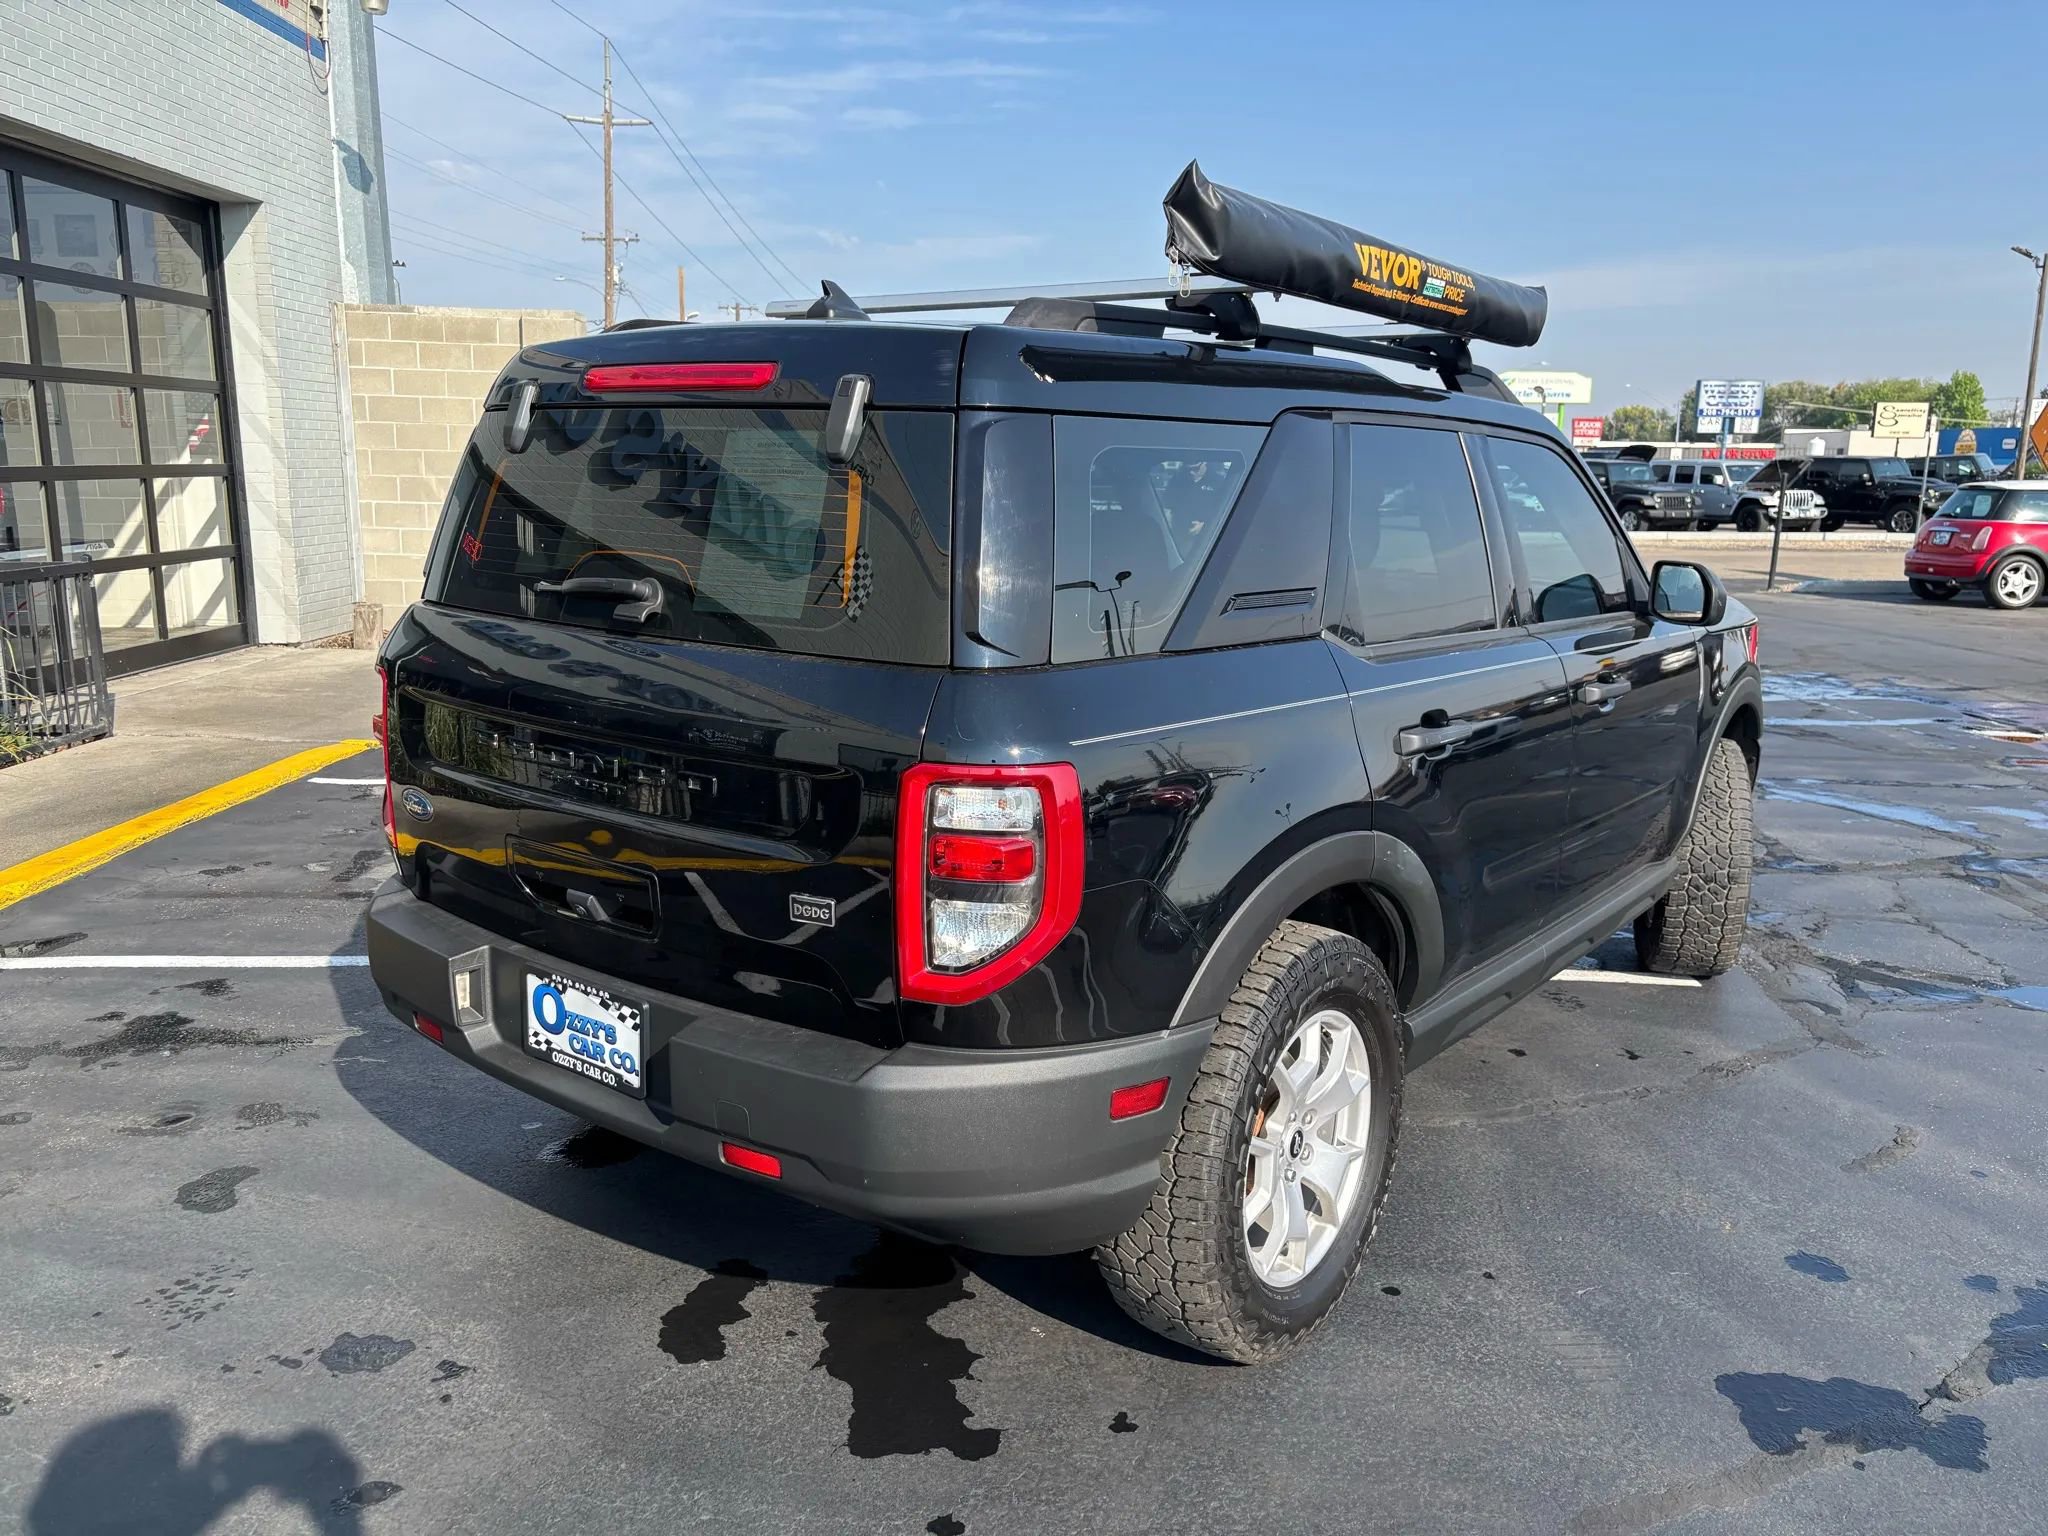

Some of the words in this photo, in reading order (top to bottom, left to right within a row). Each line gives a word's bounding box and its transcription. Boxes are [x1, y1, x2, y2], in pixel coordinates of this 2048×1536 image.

[1426, 262, 1452, 282] TOUGH
[1443, 285, 1466, 303] PRICE
[1574, 420, 1601, 429] LIQUOR
[793, 903, 830, 920] DGDG
[532, 983, 618, 1045] OZZY'S
[568, 1033, 606, 1064] CAR
[608, 1048, 640, 1077] CO.
[551, 1051, 583, 1072] OZZY'S
[583, 1063, 602, 1080] CAR
[602, 1070, 618, 1087] CO.
